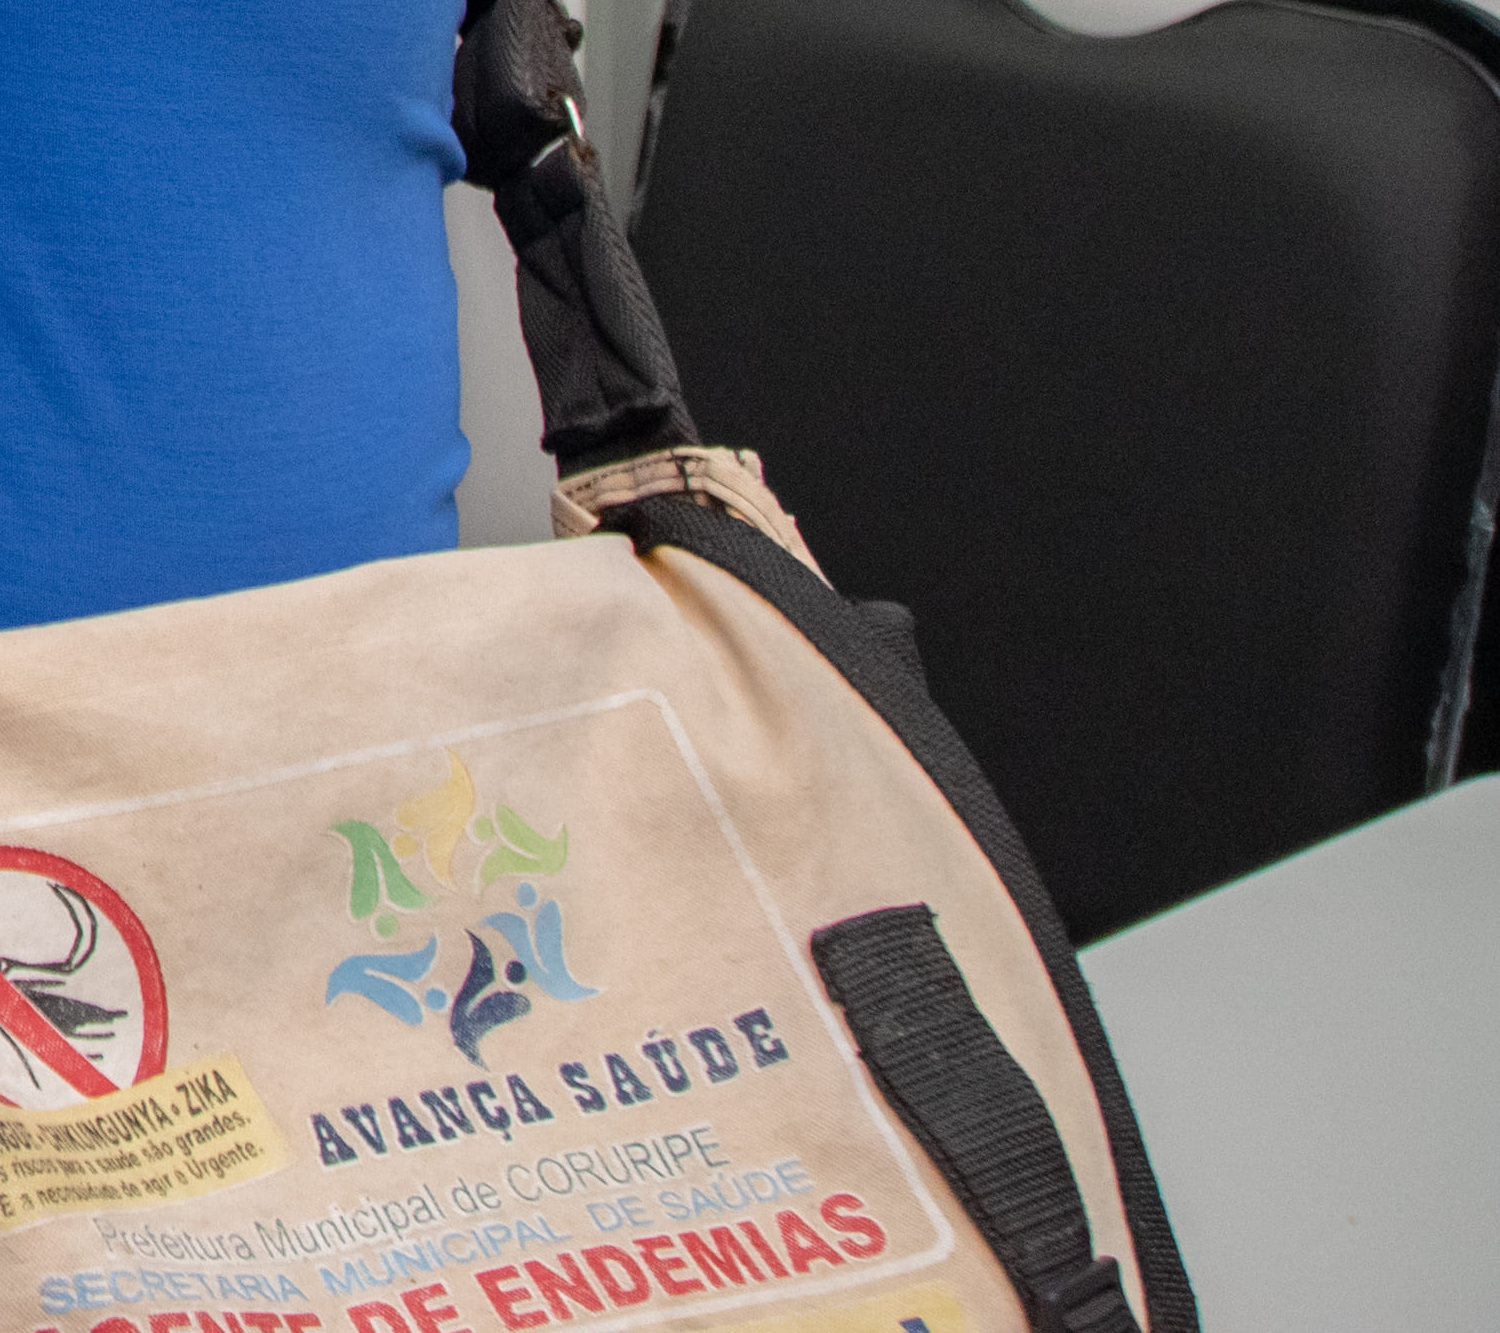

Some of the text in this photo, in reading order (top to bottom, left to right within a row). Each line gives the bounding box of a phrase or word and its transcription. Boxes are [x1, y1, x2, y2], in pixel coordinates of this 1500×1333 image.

[175, 1111, 251, 1157] grandes.
[176, 1070, 238, 1118] ZIKA
[310, 1007, 790, 1166] AVANÇA SAÚDE
[93, 1125, 731, 1261] Prefeitura Municipal de CORURIPE
[183, 1140, 264, 1180] Urgente.
[38, 1158, 815, 1315] SECRETARIA MUNICIPAL DE SAÚDE
[474, 1193, 888, 1332] ENDEMIAS
